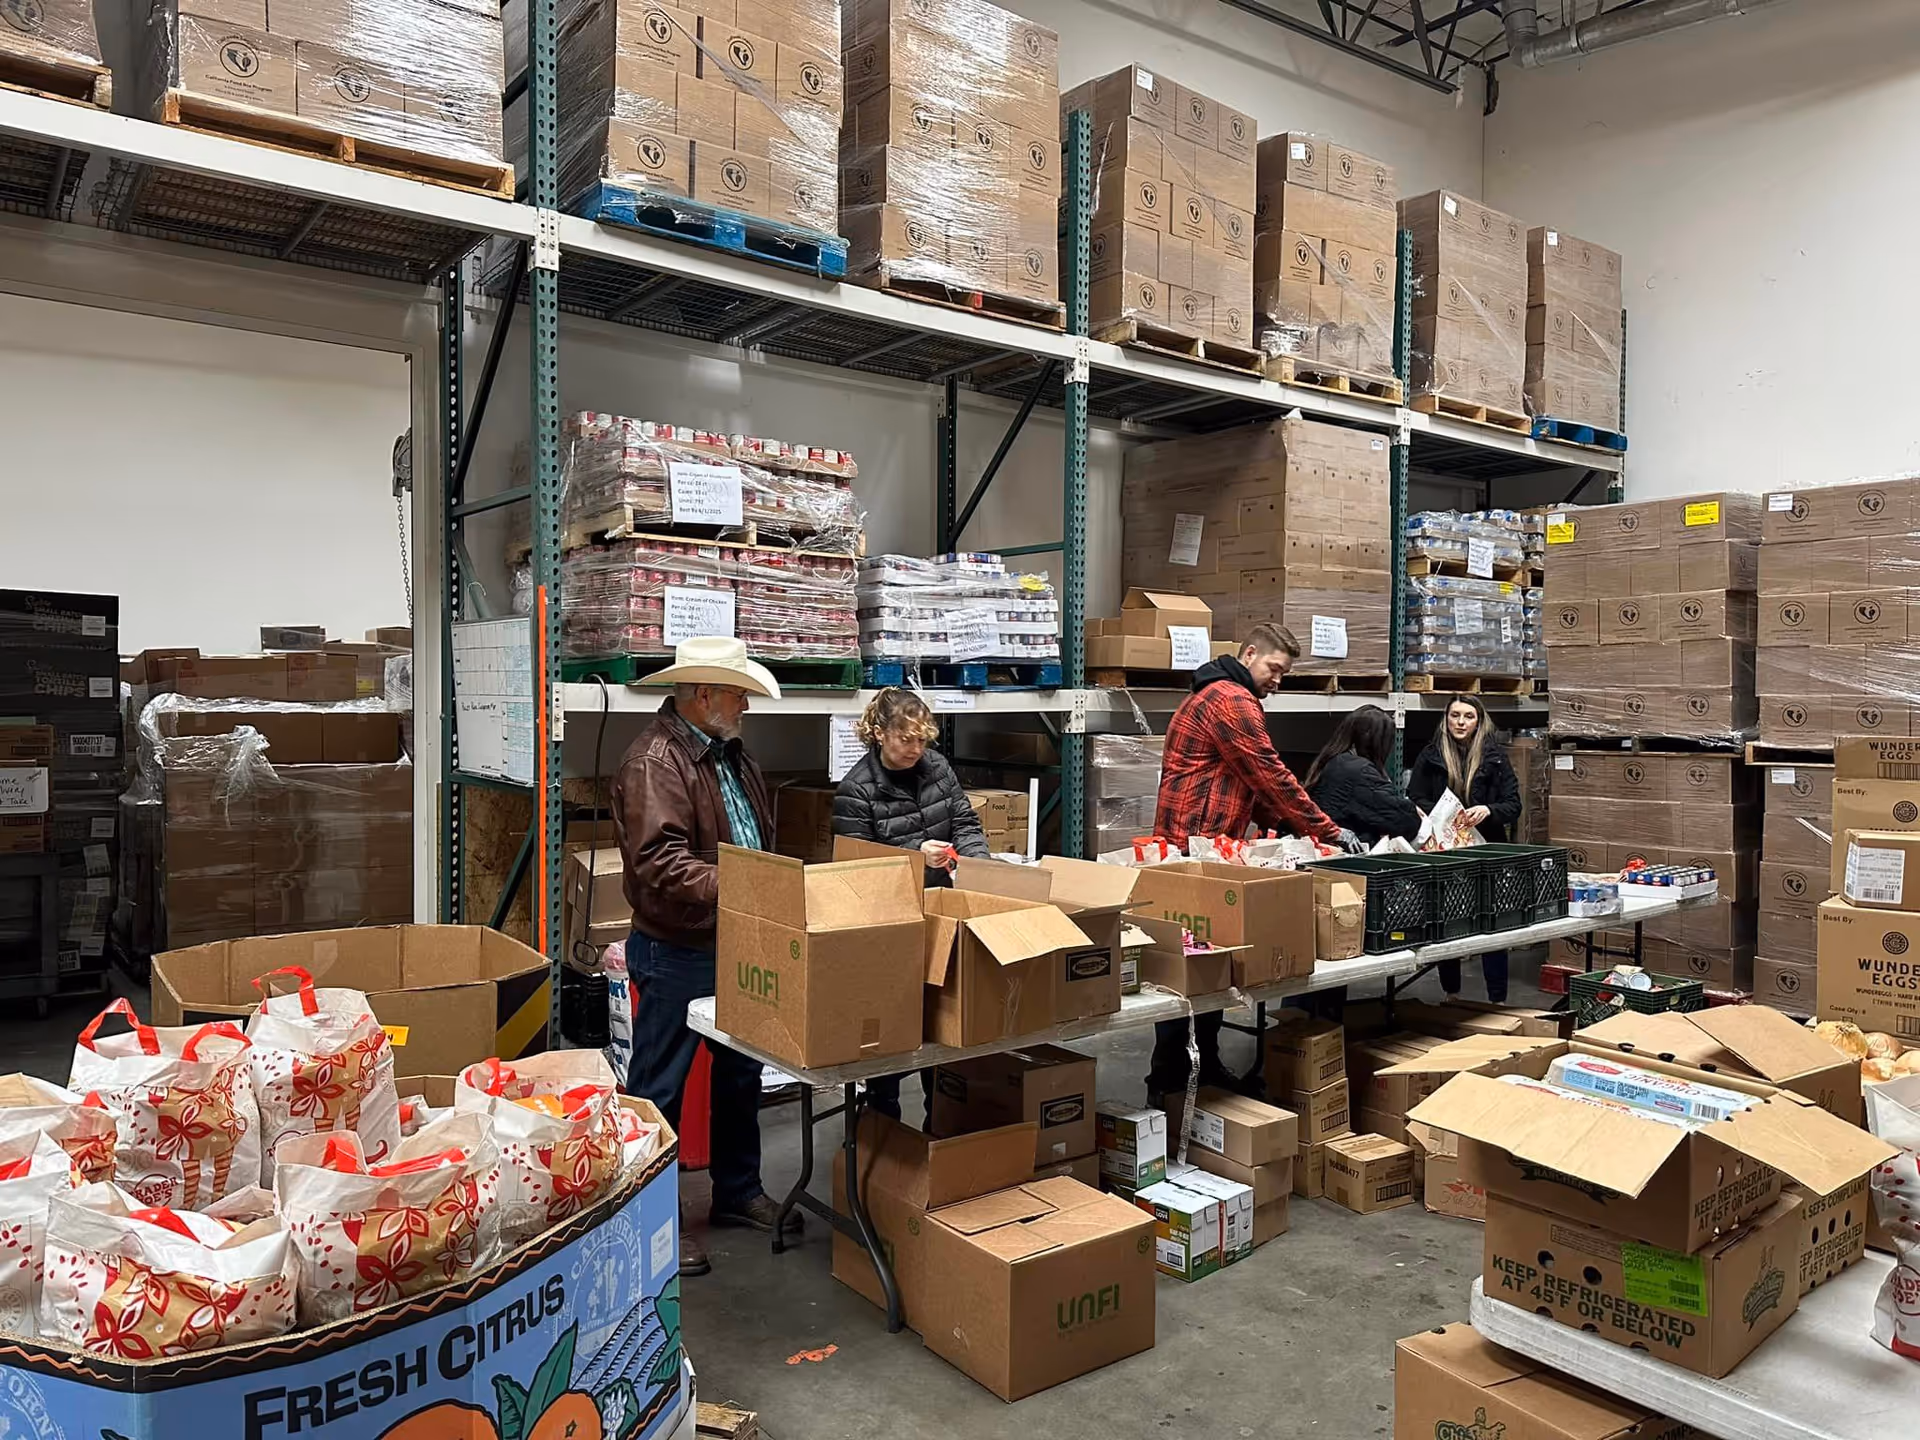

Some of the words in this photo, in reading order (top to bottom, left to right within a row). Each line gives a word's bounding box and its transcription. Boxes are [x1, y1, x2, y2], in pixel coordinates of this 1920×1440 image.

[34, 684, 86, 698] CHIPS
[1869, 742, 1920, 752] WUNDER
[1880, 751, 1913, 761] EGGS
[1823, 914, 1841, 922] Best
[738, 961, 779, 1001] UNFI
[1872, 972, 1918, 990] EGGS
[1830, 1004, 1846, 1013] Case
[143, 1188, 173, 1205] OE'S
[1694, 1196, 1717, 1218] KEEP
[1698, 1214, 1710, 1232] AT
[1732, 1198, 1744, 1213] OR
[1745, 1181, 1772, 1206] BELOW
[1808, 1201, 1826, 1219] SEFS
[1828, 1177, 1867, 1210] COMPLIANT
[1814, 1222, 1863, 1261] REFRIGERATED
[1825, 1254, 1836, 1267] OR
[1837, 1238, 1860, 1261] BELOW
[1058, 1284, 1120, 1329] UNFI
[1493, 1254, 1538, 1281] KEEP
[1544, 1273, 1696, 1337] REFRIGERATED
[1502, 1274, 1525, 1293] AT
[1530, 1284, 1571, 1309] 45°F
[1578, 1300, 1605, 1323] OR
[1612, 1315, 1683, 1349] BELOW
[244, 1344, 427, 1440] FRESH
[438, 1274, 565, 1382] CITRUS
